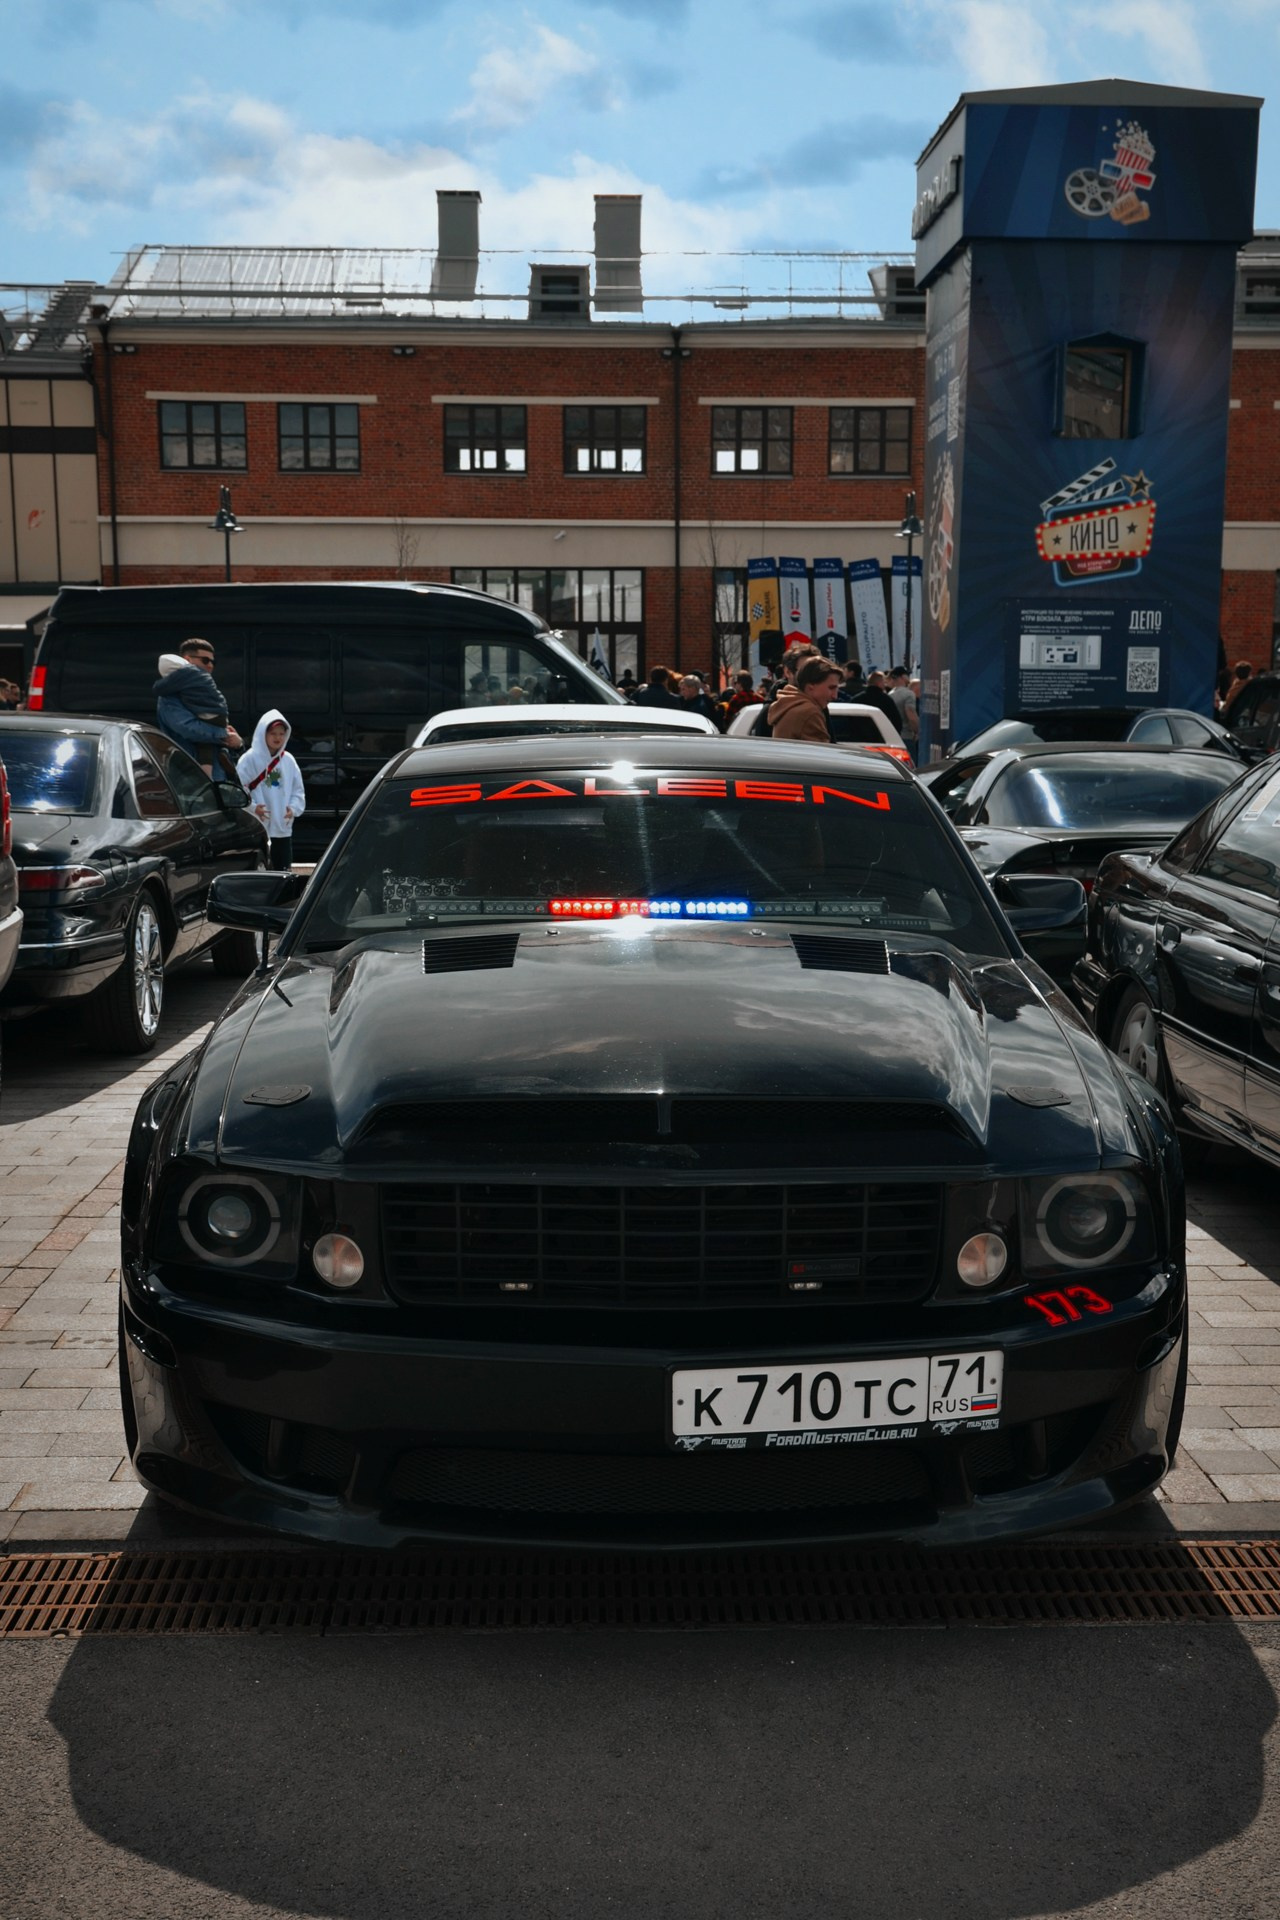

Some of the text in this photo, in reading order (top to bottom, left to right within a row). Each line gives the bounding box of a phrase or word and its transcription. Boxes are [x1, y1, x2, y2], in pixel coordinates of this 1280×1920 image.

[1070, 516, 1119, 551] КИНО
[1128, 610, 1162, 630] ДЕПО
[861, 611, 872, 665] GROUPAUTO
[409, 777, 891, 811] SALEEN
[1024, 1285, 1114, 1327] 173
[937, 1356, 985, 1398] 71
[933, 1399, 968, 1414] RUS
